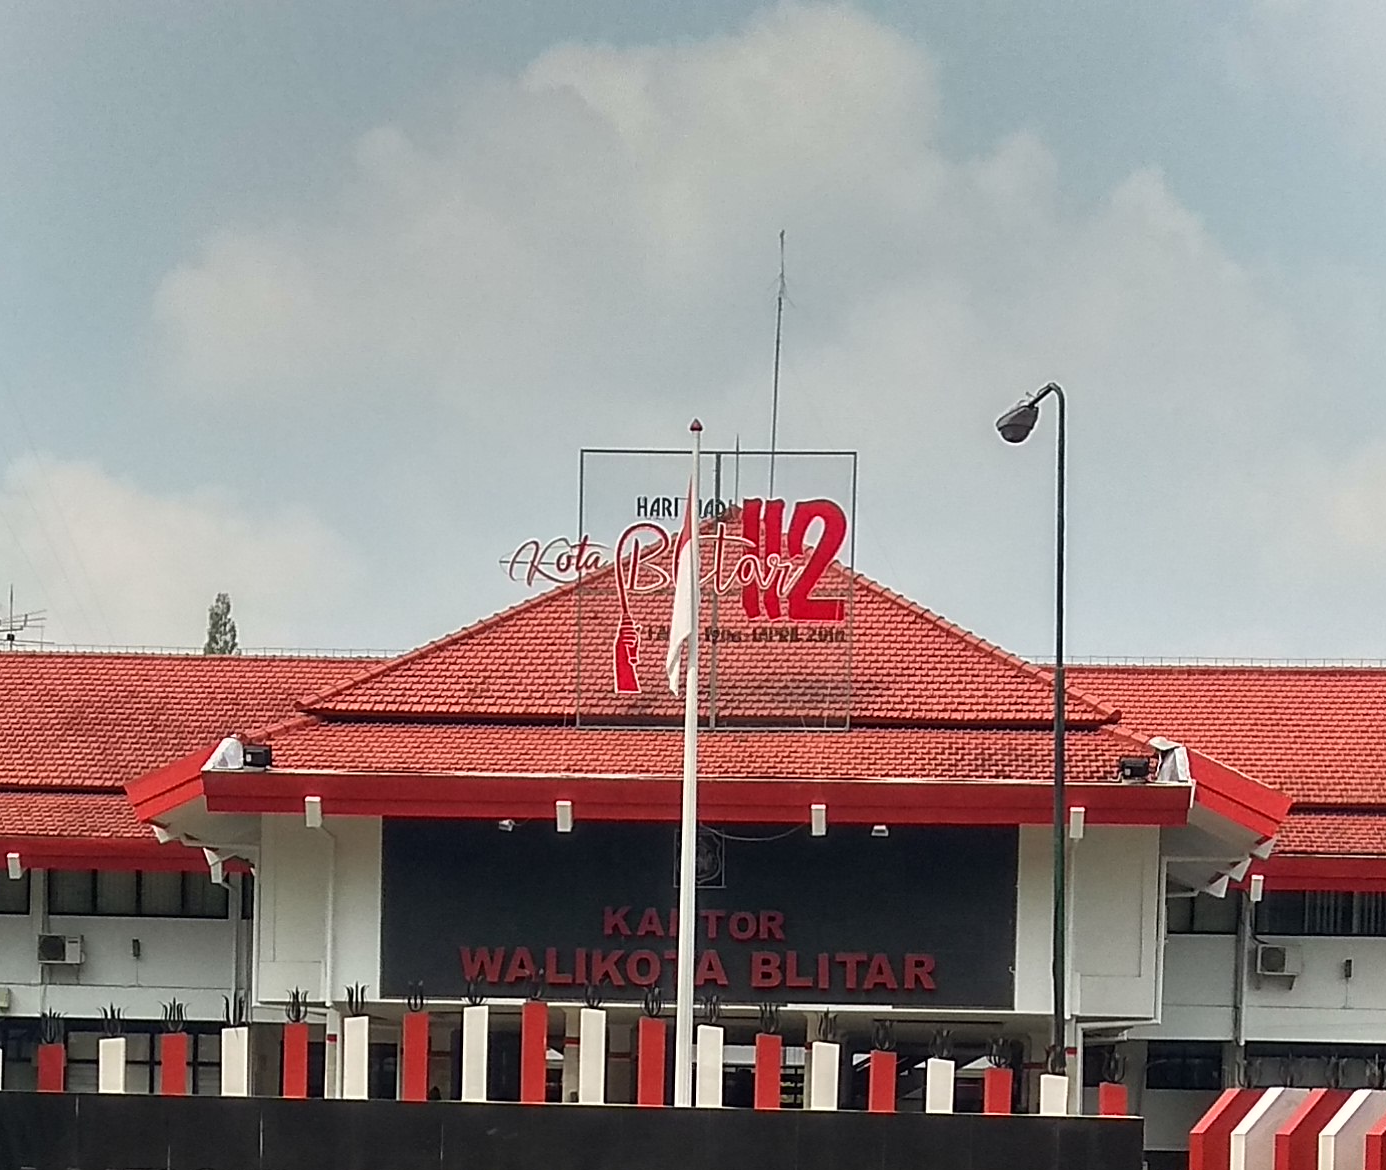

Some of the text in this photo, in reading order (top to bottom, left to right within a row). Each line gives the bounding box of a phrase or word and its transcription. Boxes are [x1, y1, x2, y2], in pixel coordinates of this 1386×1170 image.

[637, 496, 678, 518] HARI
[499, 534, 611, 587] Kota
[741, 498, 847, 621] 112
[751, 951, 936, 989] BLITAR
